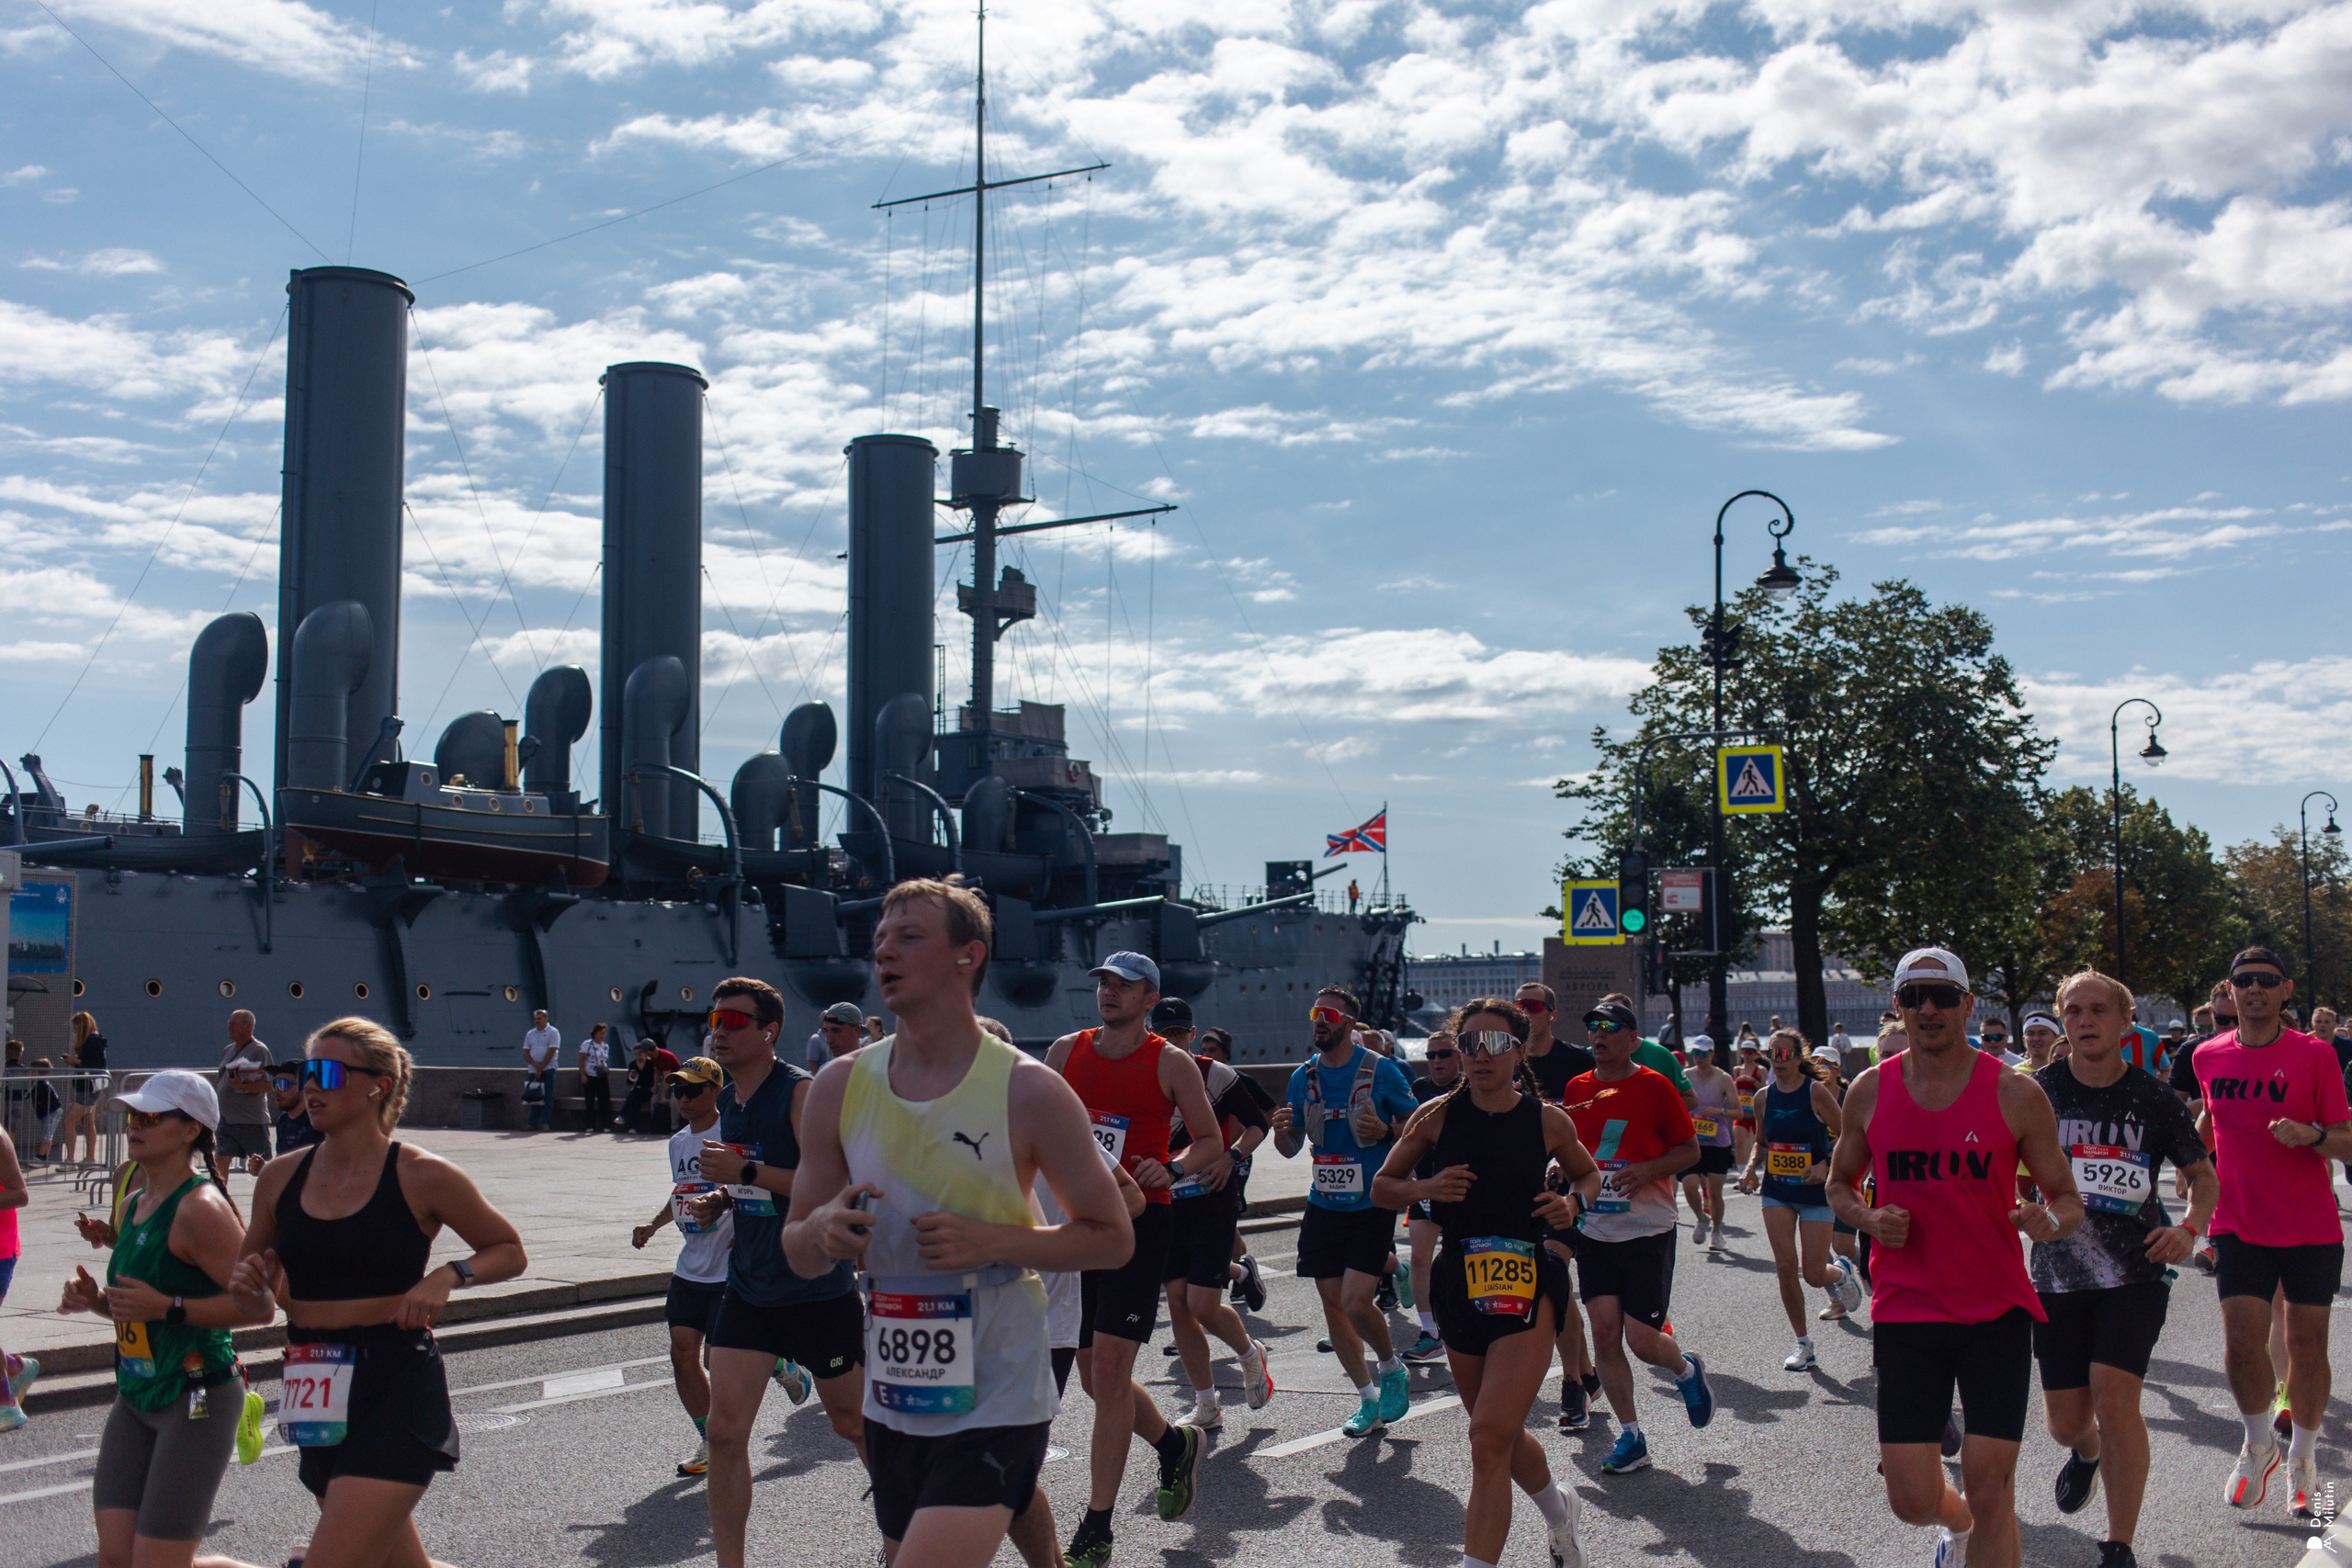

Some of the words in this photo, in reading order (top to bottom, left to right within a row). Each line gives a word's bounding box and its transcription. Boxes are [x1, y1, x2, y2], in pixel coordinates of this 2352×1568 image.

[1565, 982, 1610, 991] АВРОРА
[677, 1156, 700, 1175] AG
[1773, 1155, 1805, 1168] 5388
[1318, 1168, 1355, 1183] 5329
[2083, 1164, 2141, 1190] 5926
[2098, 1184, 2127, 1195] ВИКТОР
[676, 1201, 691, 1216] 73
[1467, 1258, 1533, 1284] 11285
[1485, 1283, 1512, 1292] LIAISIAN
[917, 1303, 935, 1312] 21,1
[117, 1321, 137, 1345] 06
[877, 1326, 956, 1364] 6898
[310, 1349, 323, 1359] 21,1
[886, 1366, 945, 1380] АЛЕКСАНДР
[284, 1377, 332, 1410] 7721
